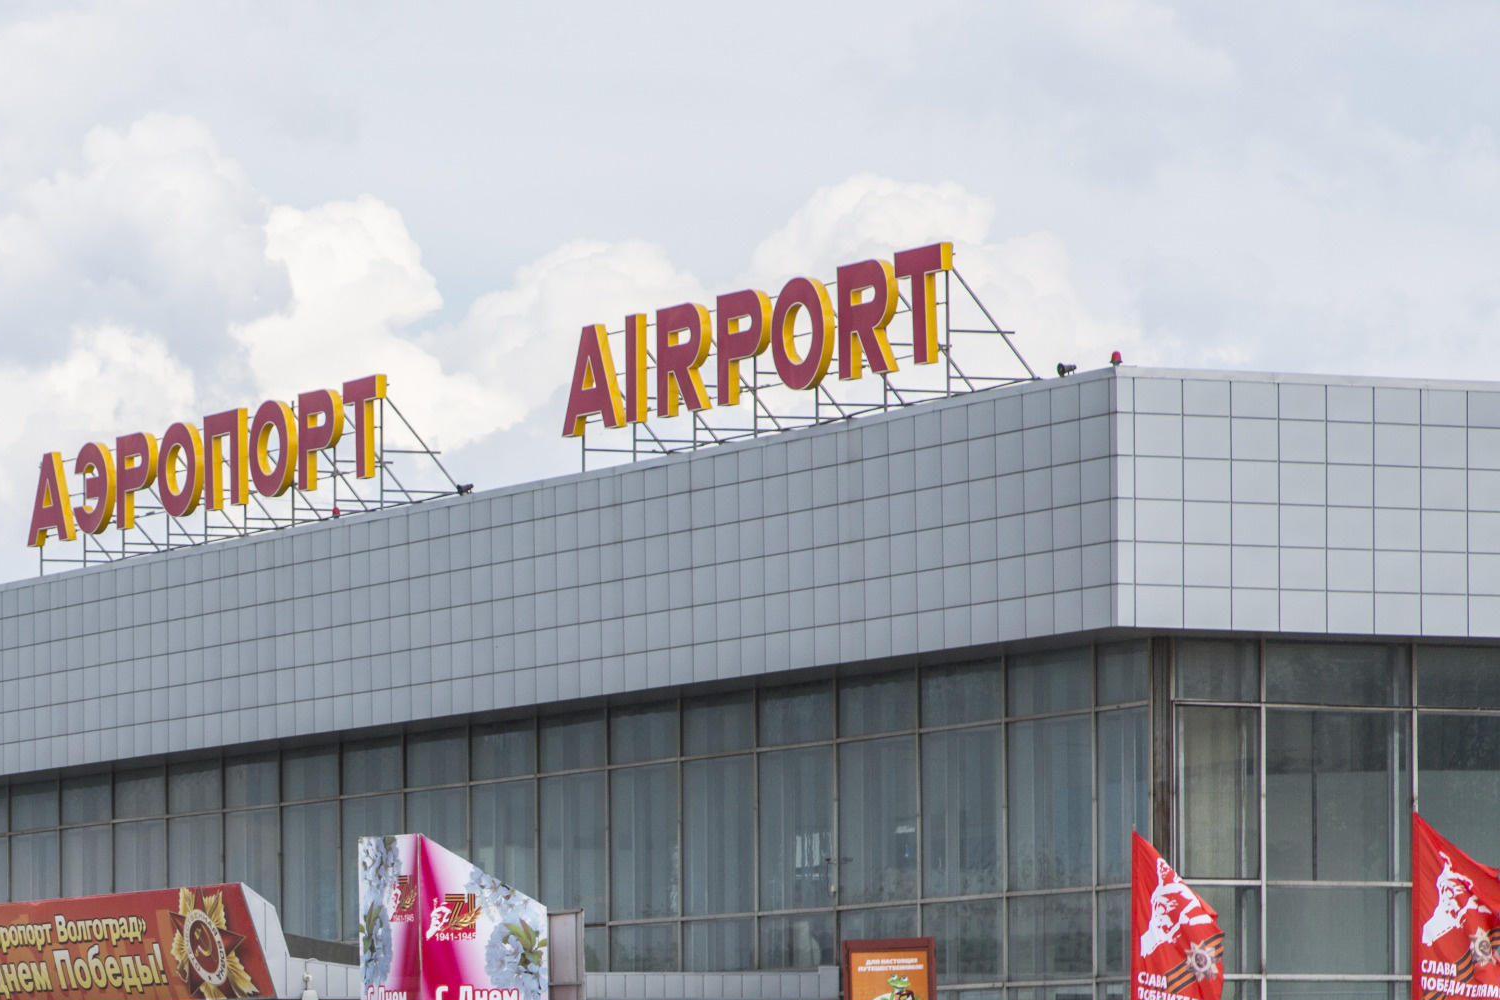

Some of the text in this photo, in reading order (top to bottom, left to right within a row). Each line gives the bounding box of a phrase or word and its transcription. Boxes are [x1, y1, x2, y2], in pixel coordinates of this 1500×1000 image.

[562, 242, 953, 437] AIRPORT
[27, 374, 387, 547] АЭРОПОРТ
[54, 914, 147, 947] Волгоград»
[435, 933, 476, 941] 1941-1945
[52, 943, 169, 995] Победы!
[1421, 959, 1457, 977] СЛАВА
